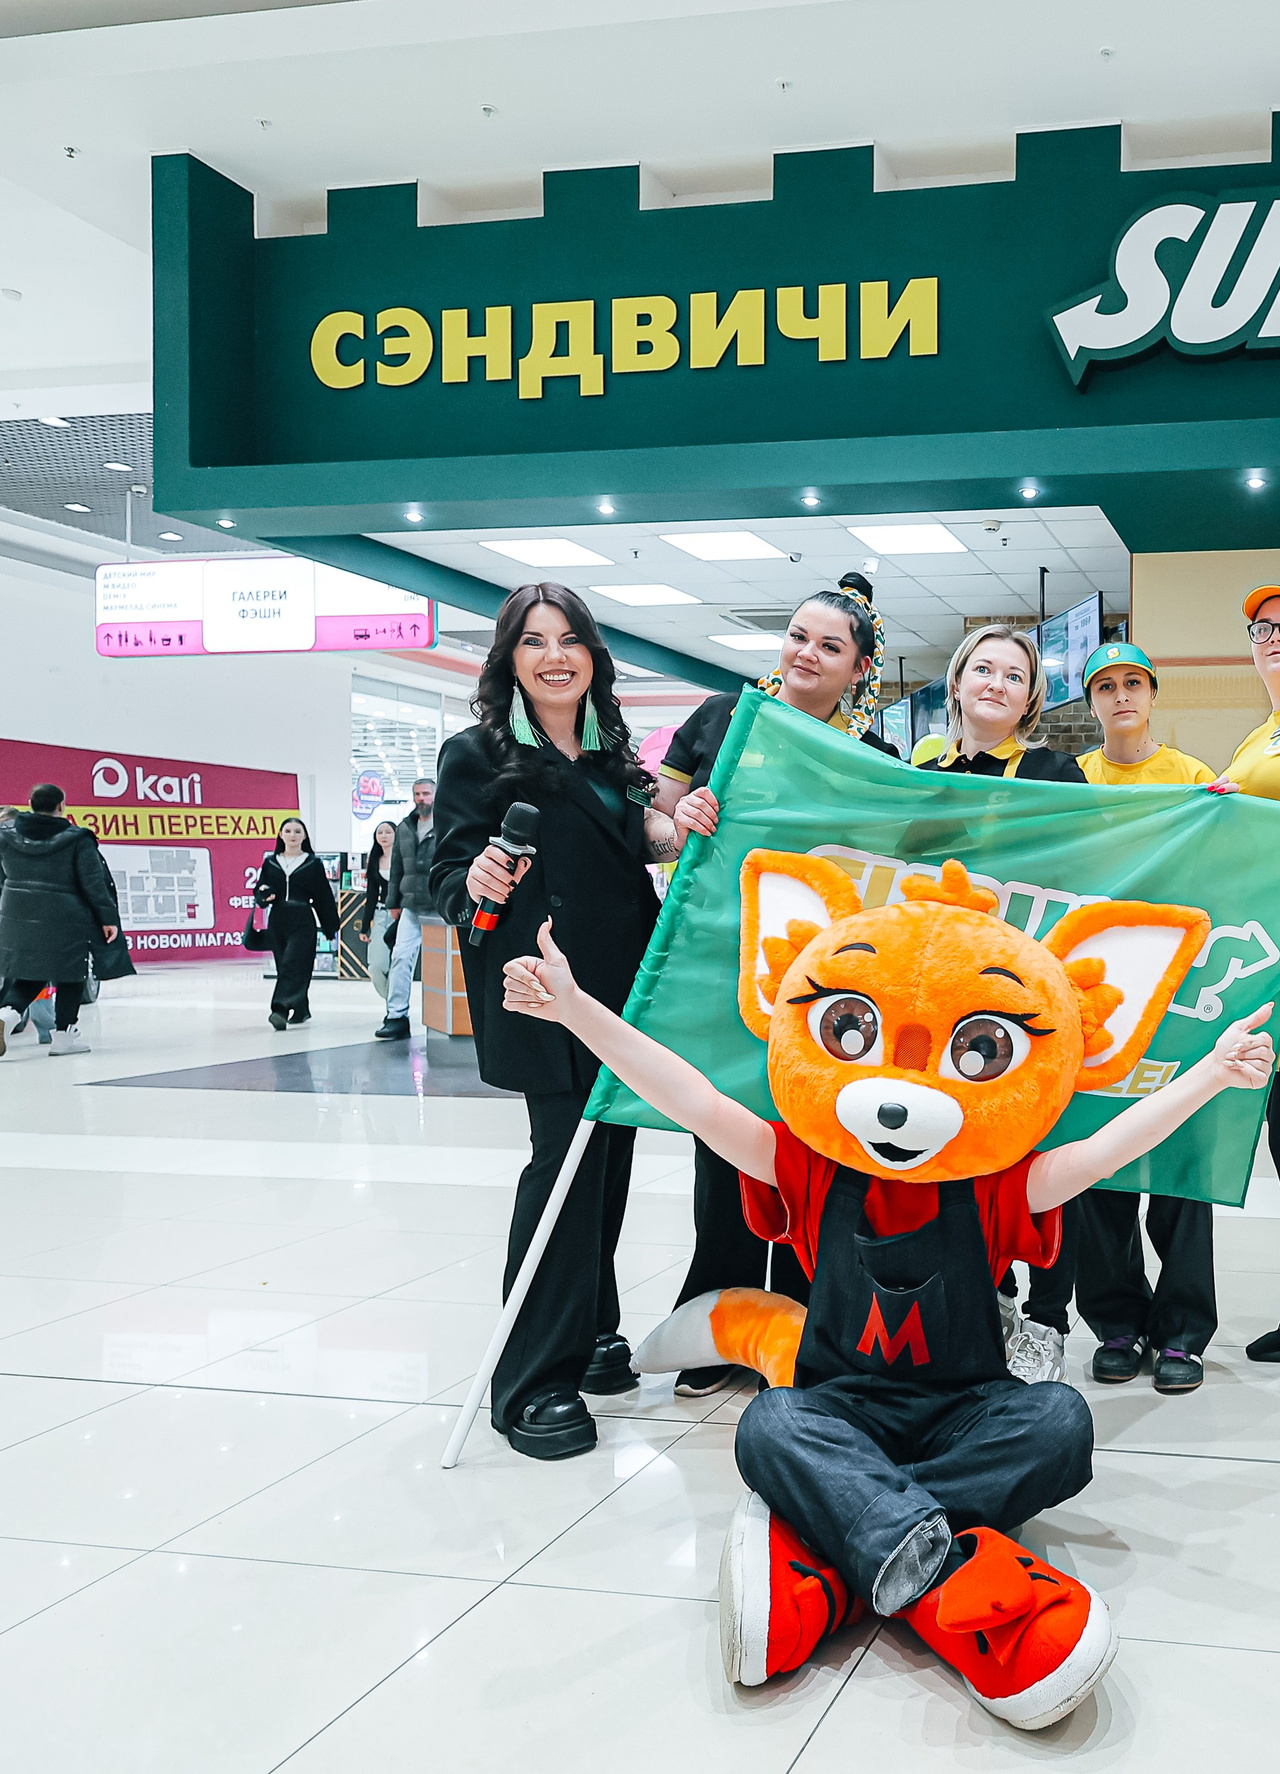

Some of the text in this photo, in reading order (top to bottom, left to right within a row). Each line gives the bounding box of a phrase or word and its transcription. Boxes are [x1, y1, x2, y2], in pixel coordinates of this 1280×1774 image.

[103, 571, 138, 580] ДЕТСКИЙ
[232, 590, 288, 602] ГАЛЕРЕИ
[103, 603, 144, 612] МАРМЕЛАД
[238, 607, 282, 620] ФЭШН
[135, 766, 203, 805] kari
[148, 814, 276, 836] ПЕРЕЕХАЛ
[244, 867, 262, 889] 2
[137, 934, 193, 949] НОВОМ
[195, 932, 245, 947] МАГАЗ
